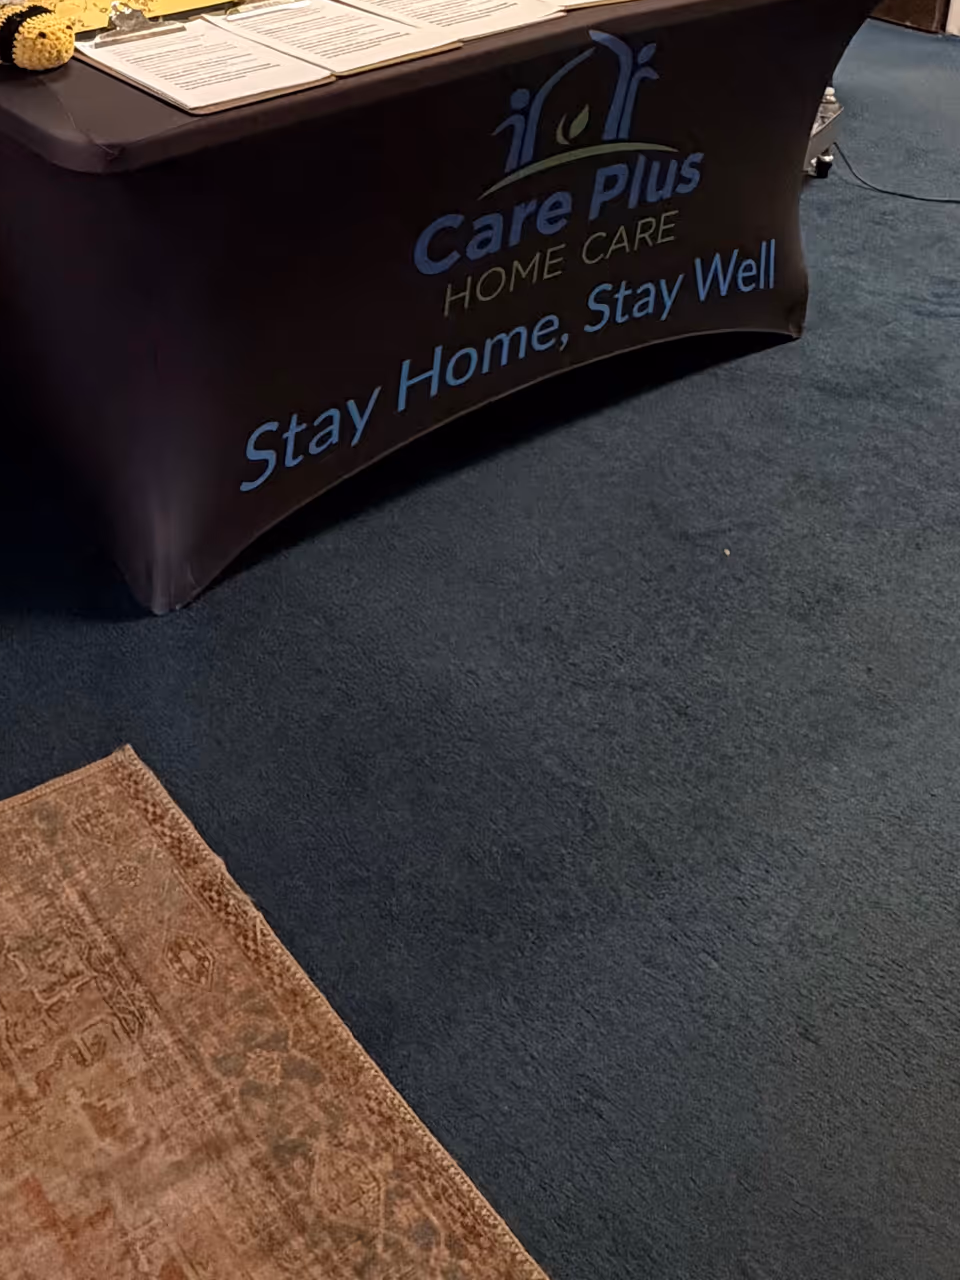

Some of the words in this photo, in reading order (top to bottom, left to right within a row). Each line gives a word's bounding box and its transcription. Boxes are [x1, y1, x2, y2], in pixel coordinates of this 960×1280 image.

[413, 190, 573, 275] Care
[589, 152, 705, 220] Plus
[443, 243, 566, 317] HOME
[581, 209, 680, 265] CARE
[239, 385, 382, 492] Stay
[396, 312, 570, 412] Home,
[583, 273, 685, 333] Stay
[694, 238, 776, 302] Well
